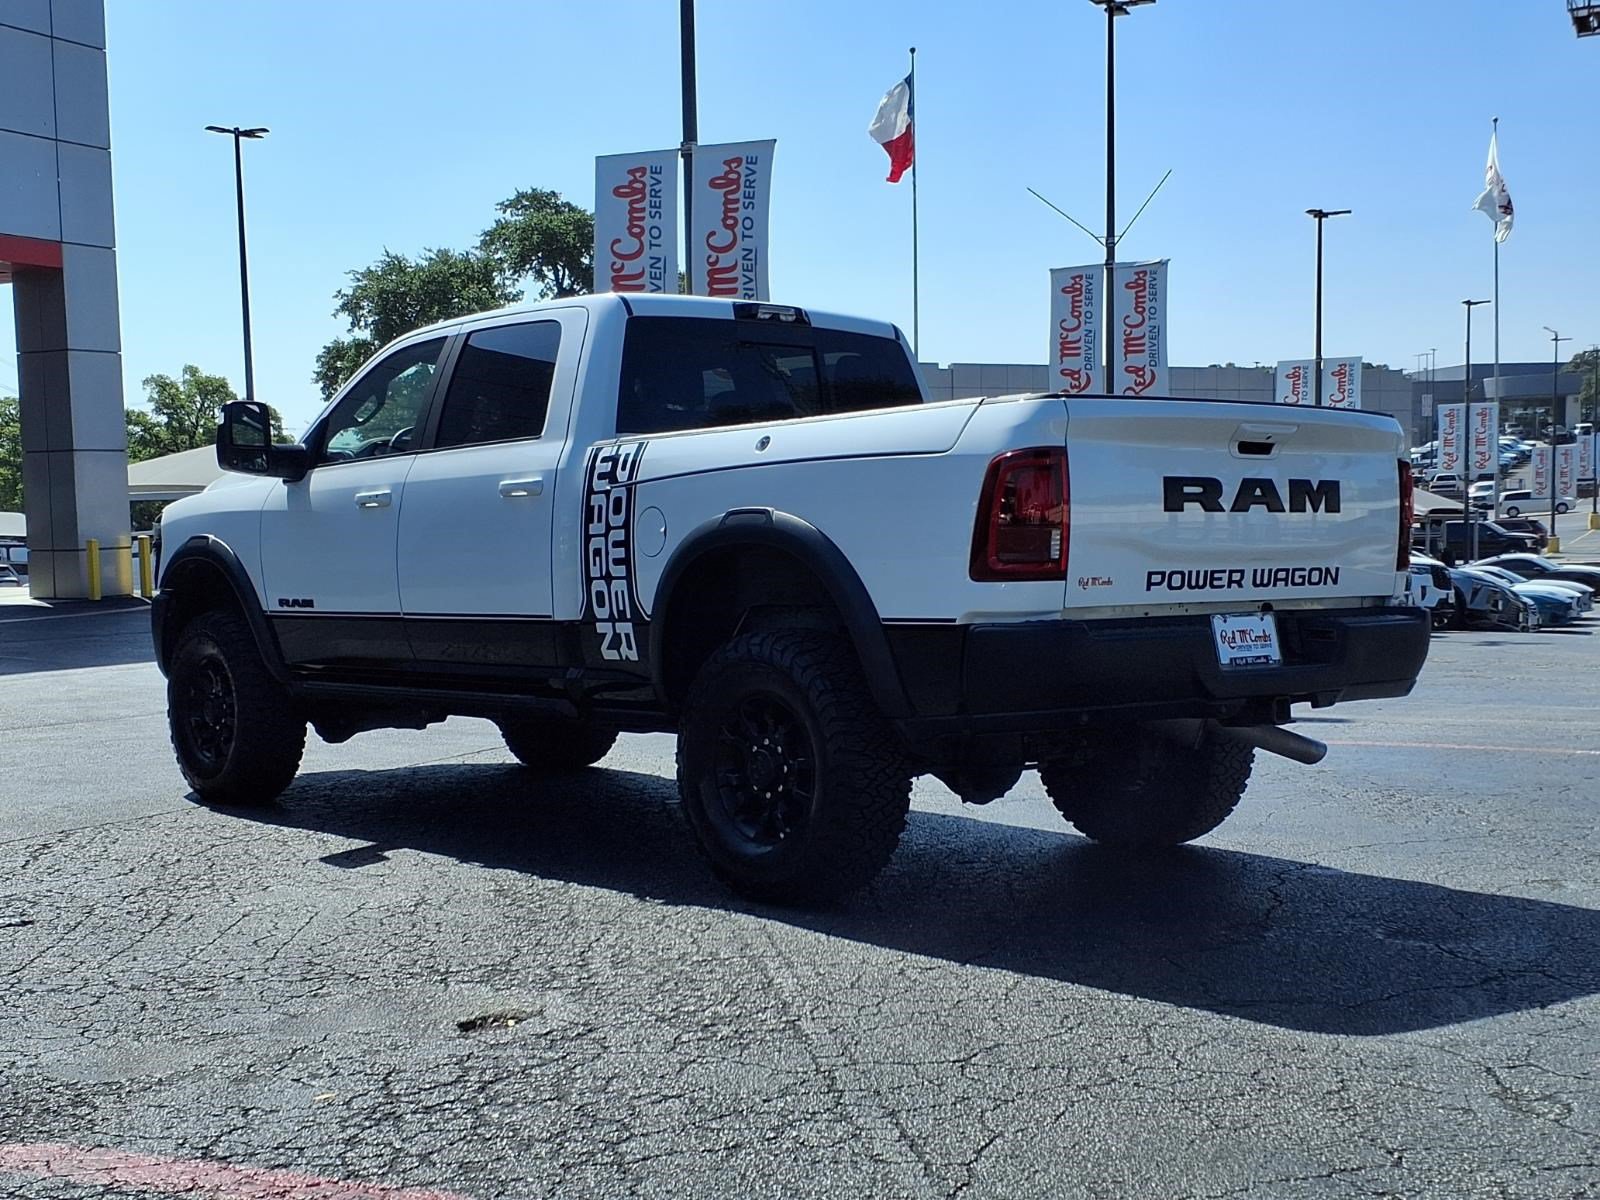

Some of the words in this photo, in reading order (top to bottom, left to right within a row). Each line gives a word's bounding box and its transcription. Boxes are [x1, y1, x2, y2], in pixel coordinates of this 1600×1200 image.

[649, 165, 662, 220] SERVE
[743, 155, 758, 211] SERVE
[649, 225, 662, 250] TO
[706, 156, 743, 297] McCombs
[741, 216, 754, 242] TO
[649, 256, 662, 293] VEN
[741, 249, 754, 300] RIVEN
[1084, 273, 1094, 308] SERVE
[1148, 269, 1158, 304] SERVE
[1059, 274, 1083, 365] McCombs
[1084, 310, 1093, 326] TO
[1123, 270, 1148, 362] McCombs
[1148, 306, 1157, 322] TO
[1084, 329, 1093, 371] DRIVEN
[1148, 325, 1158, 368] DRIVEN
[1123, 365, 1156, 395] Red
[1442, 452, 1459, 471] Red
[1474, 451, 1491, 470] Red
[1163, 476, 1341, 513] RAM
[588, 445, 621, 662] WAGON
[607, 443, 639, 662] POWER
[1146, 569, 1245, 592] POWER
[1251, 567, 1340, 588] WAGON
[278, 598, 315, 609] RAM
[1220, 629, 1237, 650] Red
[1236, 628, 1272, 644] McCombs
